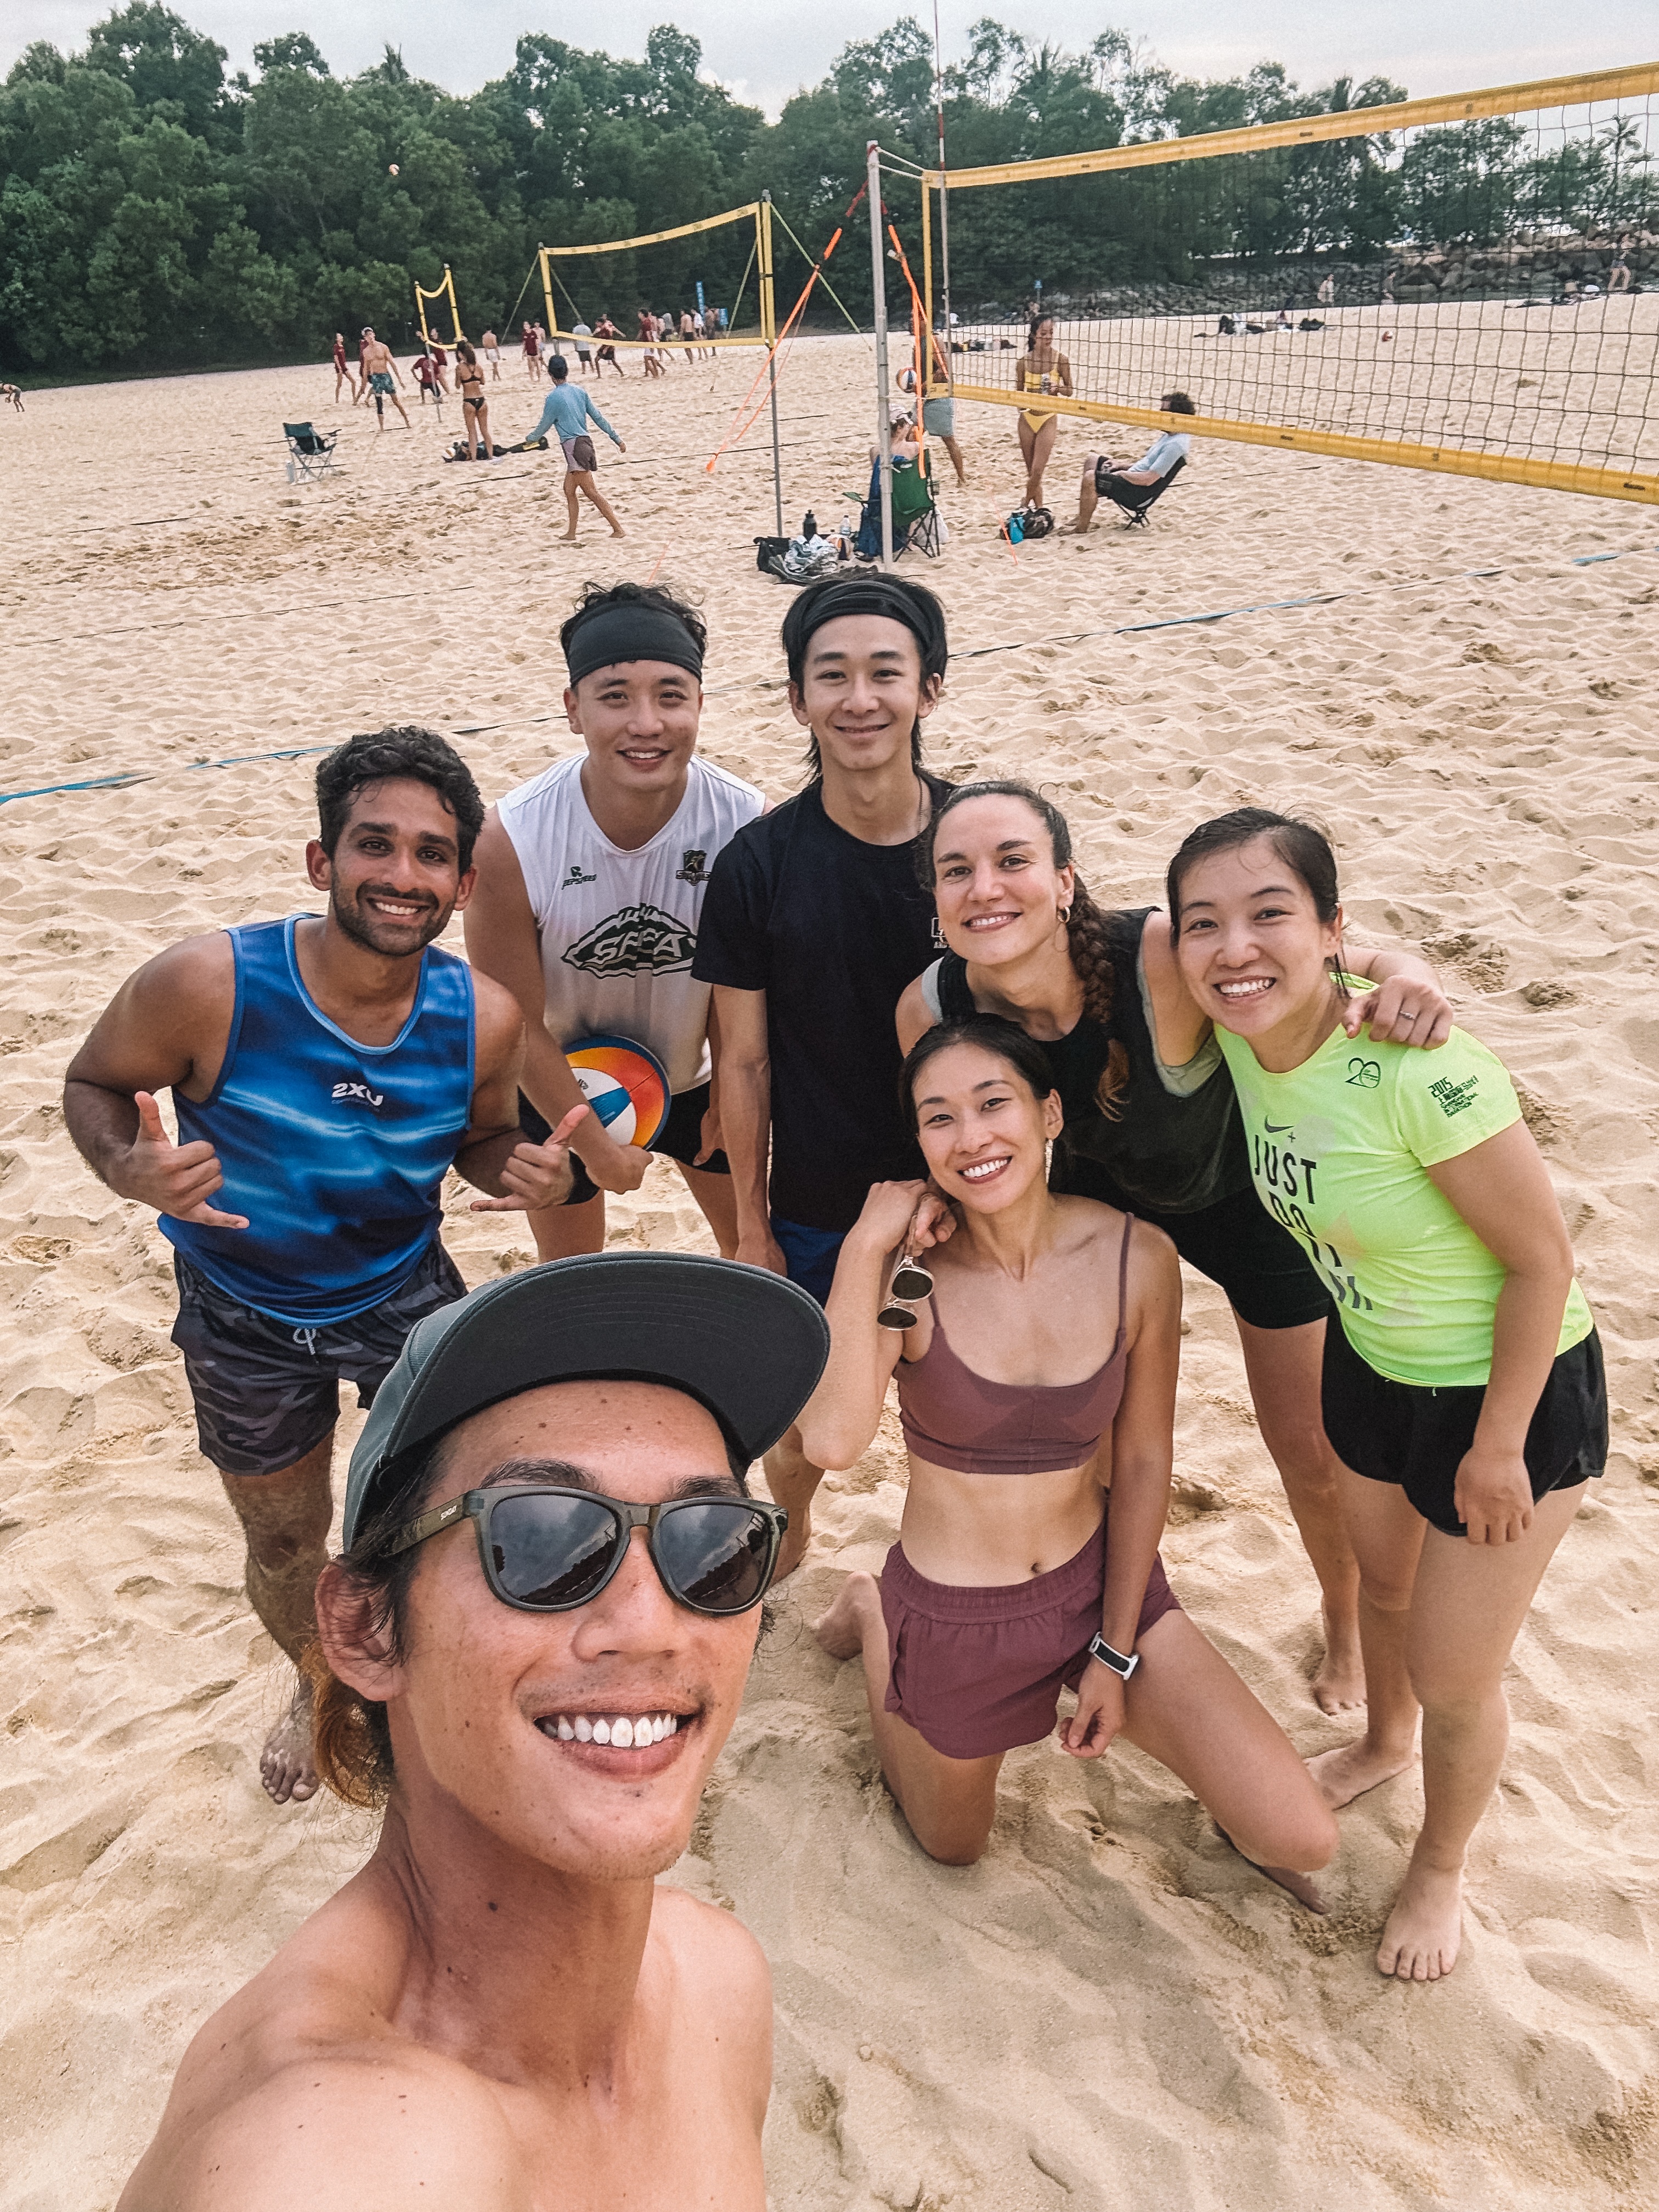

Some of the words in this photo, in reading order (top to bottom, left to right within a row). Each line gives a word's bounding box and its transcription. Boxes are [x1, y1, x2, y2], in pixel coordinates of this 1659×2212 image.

[331, 1083, 383, 1106] 2XU
[1427, 1076, 1453, 1098] 2015
[1254, 1134, 1317, 1204] JUST
[1268, 1190, 1317, 1239] DO
